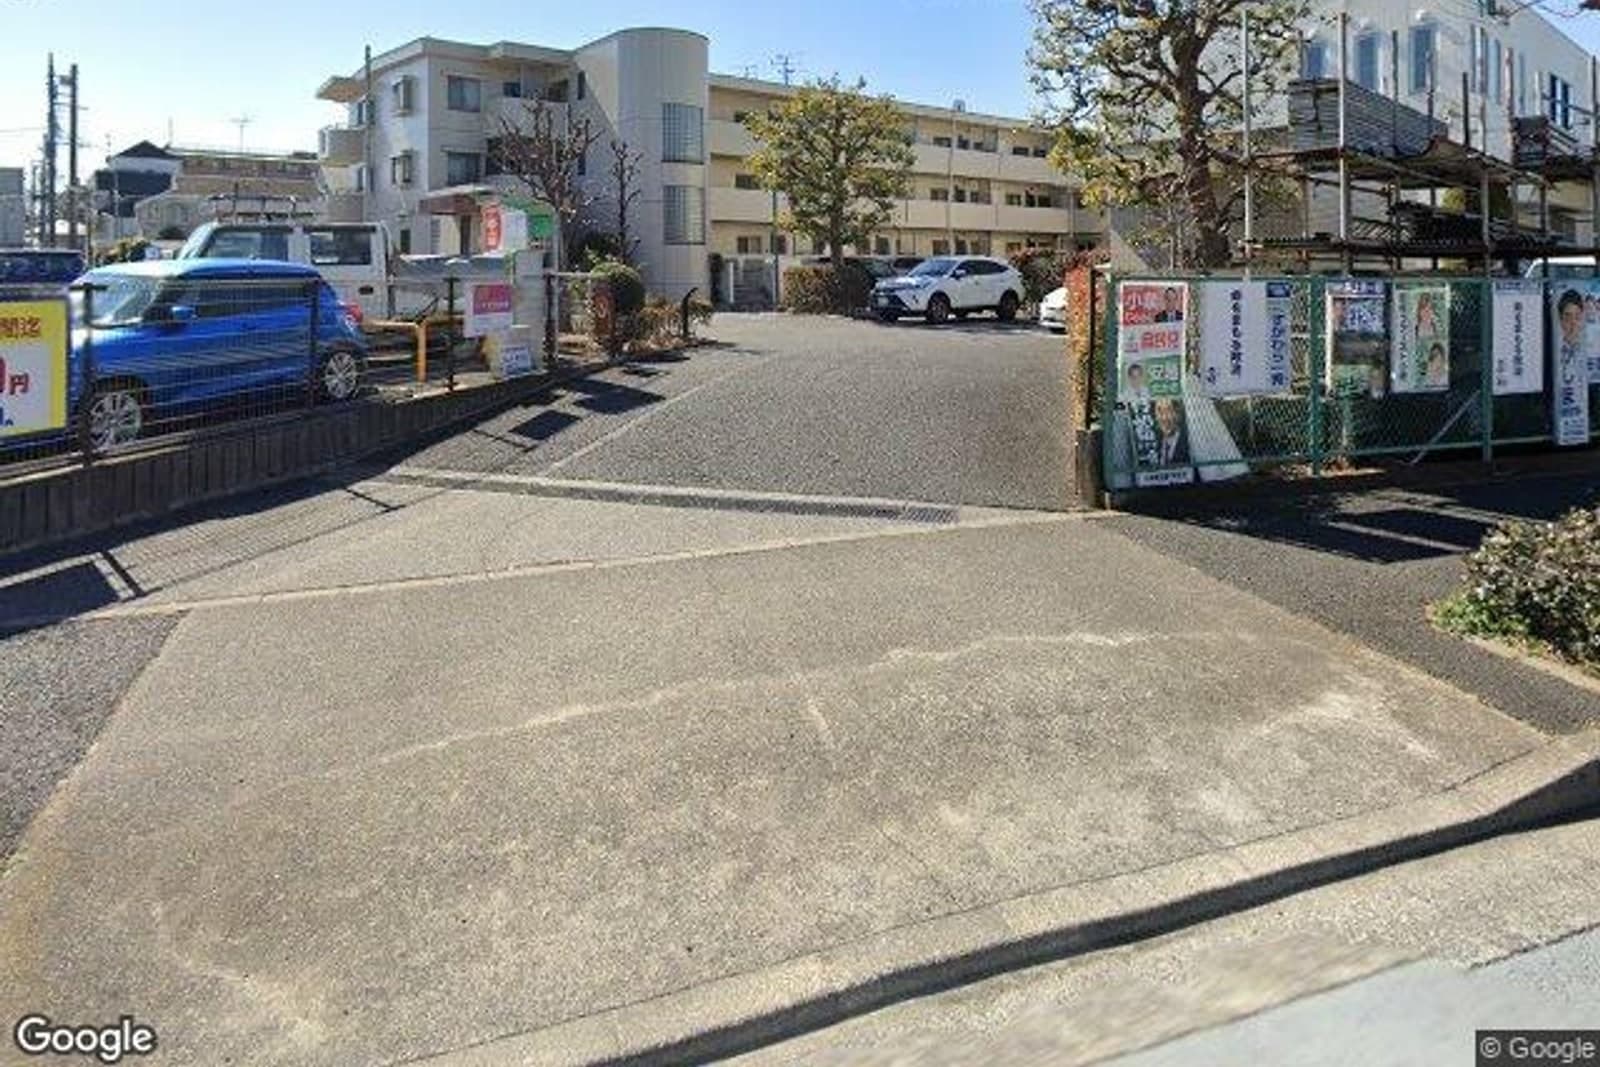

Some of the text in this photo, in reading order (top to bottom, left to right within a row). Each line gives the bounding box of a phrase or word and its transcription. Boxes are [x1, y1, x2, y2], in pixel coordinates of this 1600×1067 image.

[1271, 314, 1286, 386] すがわら一秀
